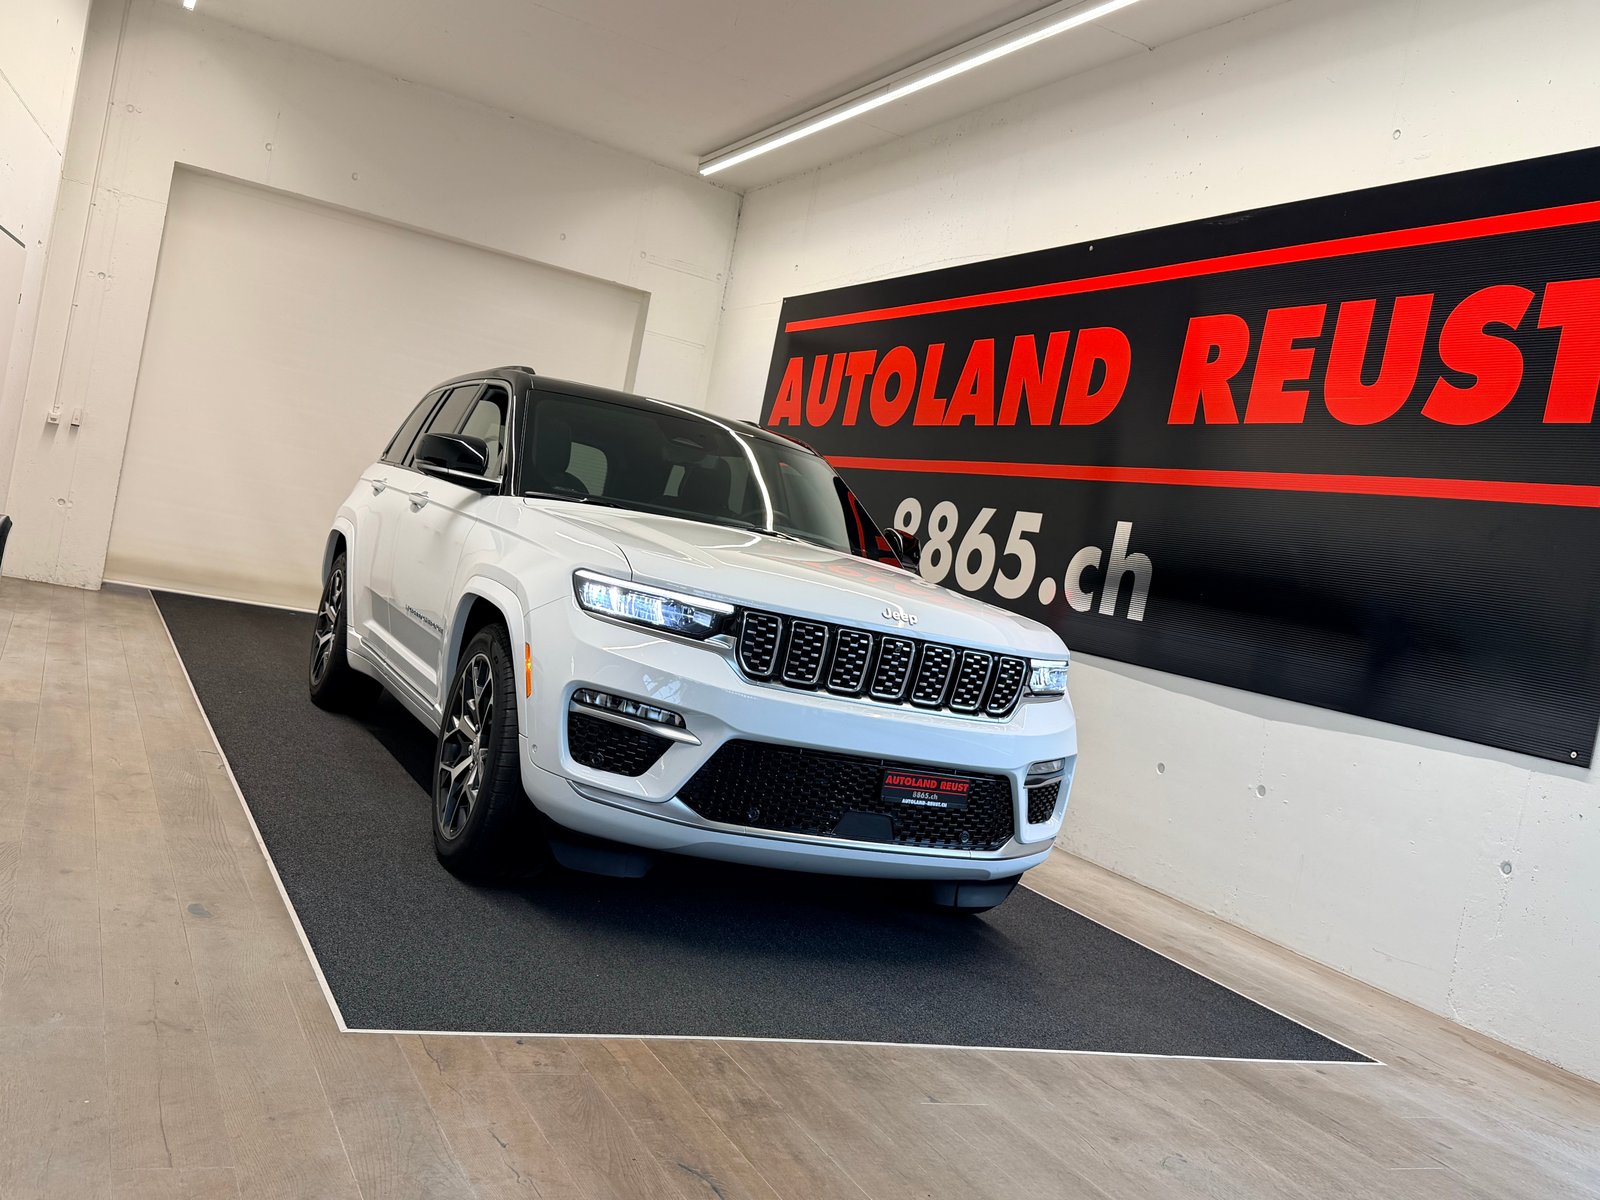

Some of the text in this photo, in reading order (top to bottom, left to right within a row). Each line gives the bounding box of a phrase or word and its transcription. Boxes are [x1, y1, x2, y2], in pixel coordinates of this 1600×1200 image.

[767, 277, 1600, 427] AUTOLAND REUST
[881, 608, 918, 626] Jeep
[885, 775, 969, 792] AUTOLAND REUST
[912, 791, 938, 800] 8865.ch
